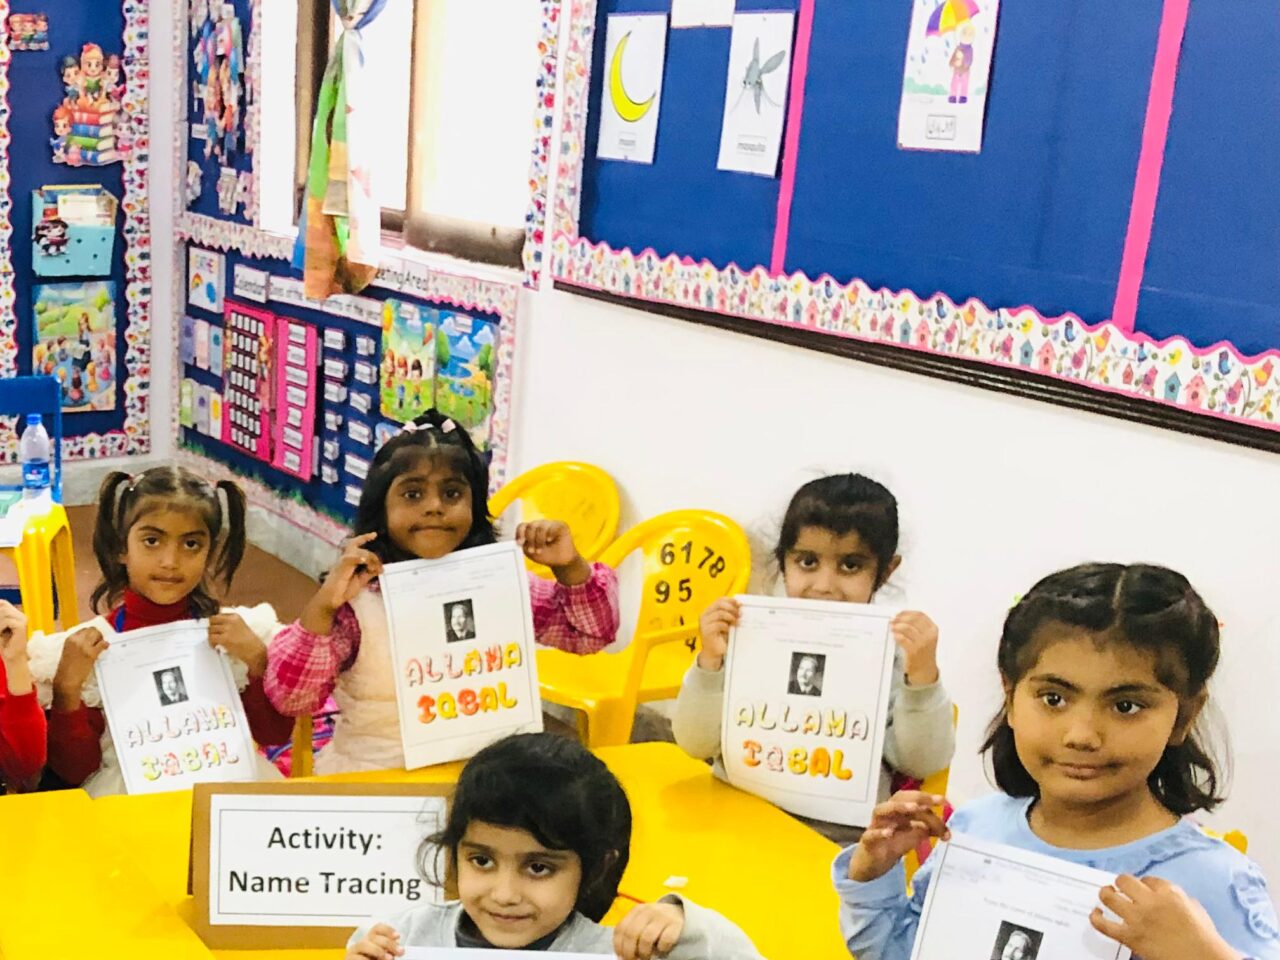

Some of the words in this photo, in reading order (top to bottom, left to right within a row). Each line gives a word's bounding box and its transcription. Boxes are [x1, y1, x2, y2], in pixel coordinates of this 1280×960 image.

[406, 641, 523, 688] ALLAMA
[416, 681, 518, 724] IQBAL
[736, 701, 870, 742] ALLAMA
[742, 739, 854, 781] IQBAL
[267, 826, 383, 856] Activity:
[229, 870, 310, 893] Name
[319, 871, 421, 901] Tracing
